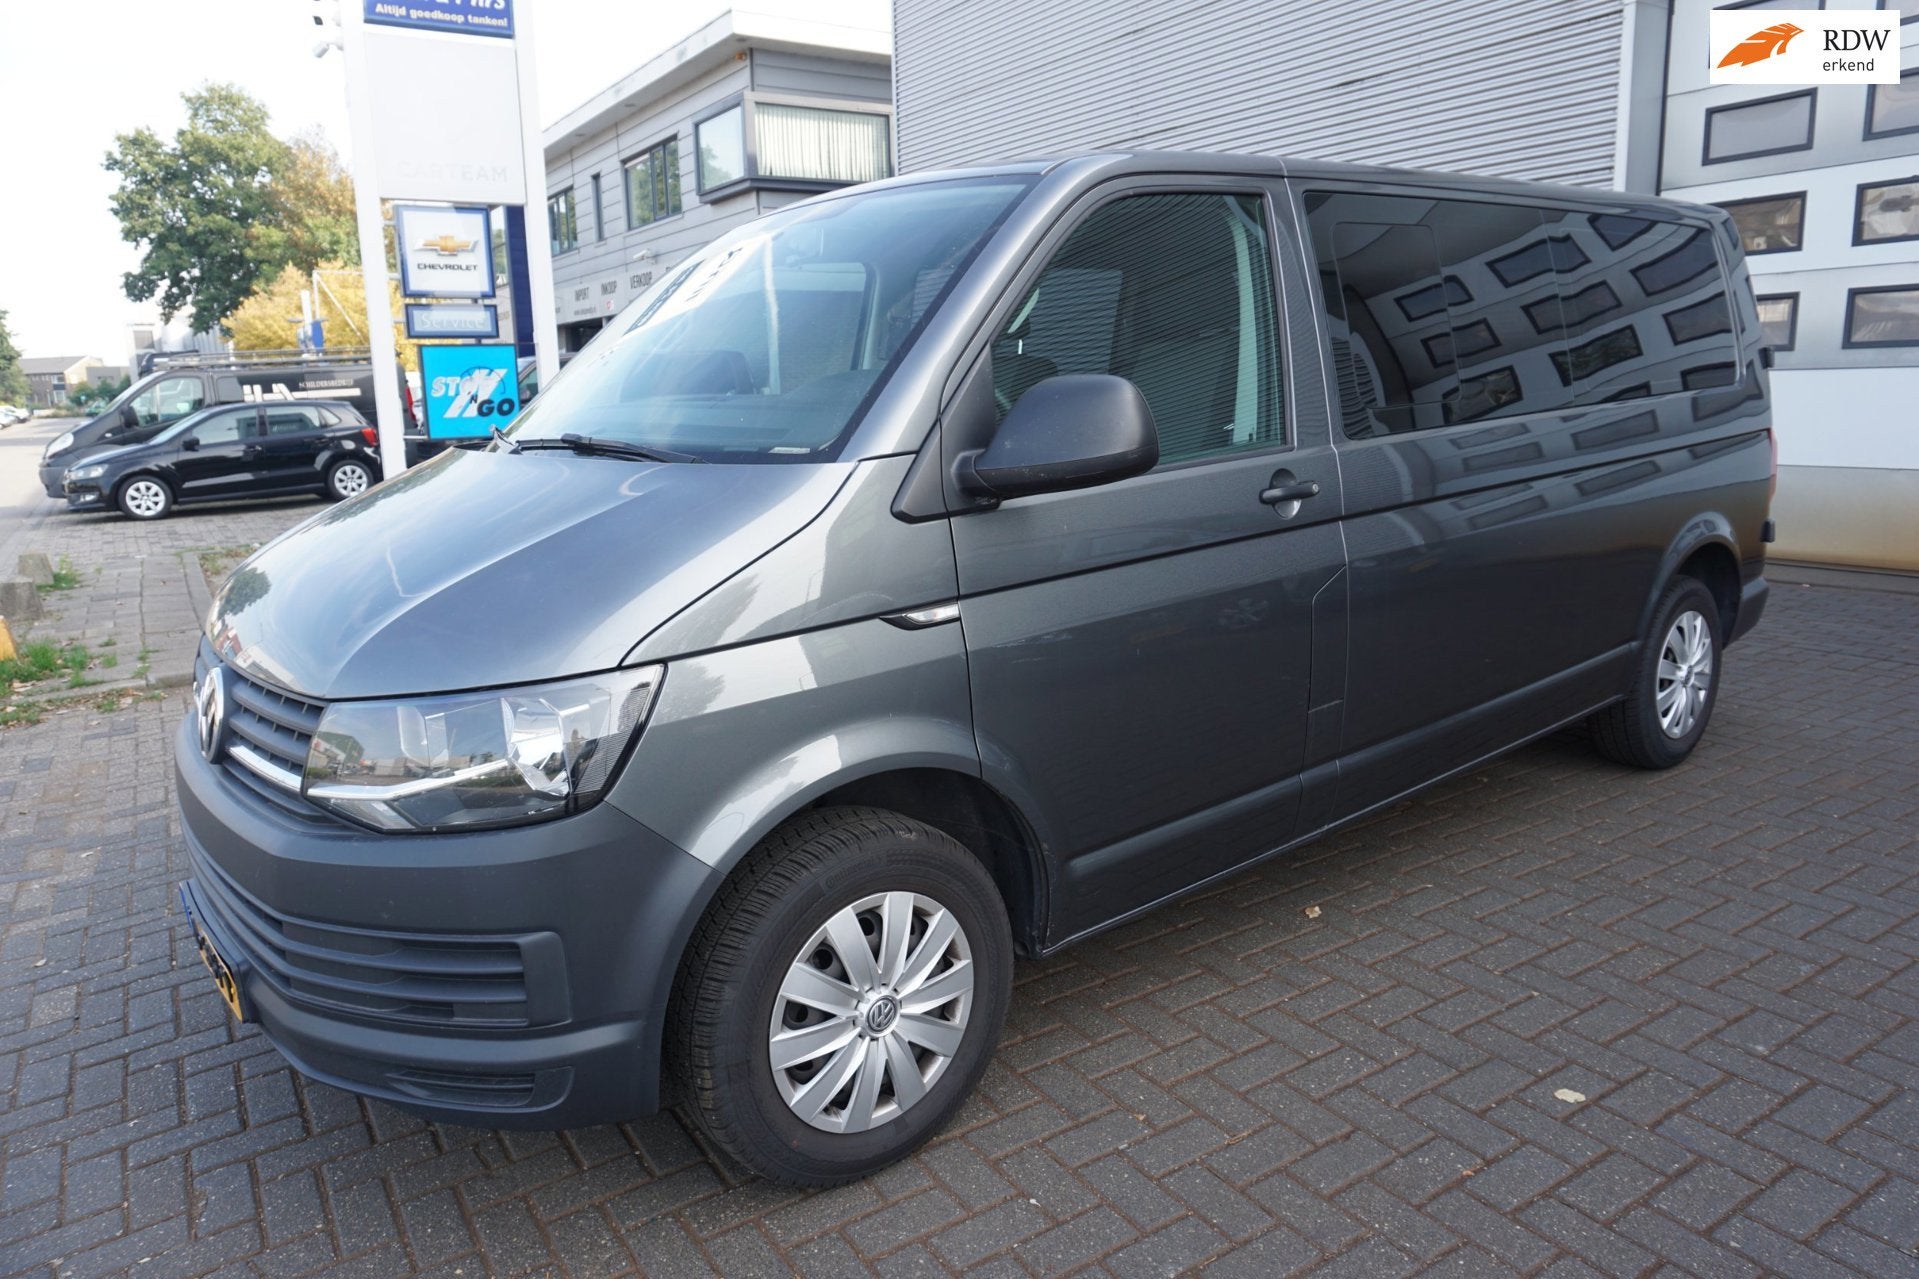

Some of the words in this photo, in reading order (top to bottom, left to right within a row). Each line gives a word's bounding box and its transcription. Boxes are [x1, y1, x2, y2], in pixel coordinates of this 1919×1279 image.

[375, 3, 406, 16] Altijd
[409, 9, 465, 23] goedkoop
[467, 14, 508, 27] tanken!
[417, 262, 478, 271] CHEVROLET
[630, 272, 653, 289] VERKOOP
[421, 312, 485, 329] Service
[477, 398, 515, 417] GO
